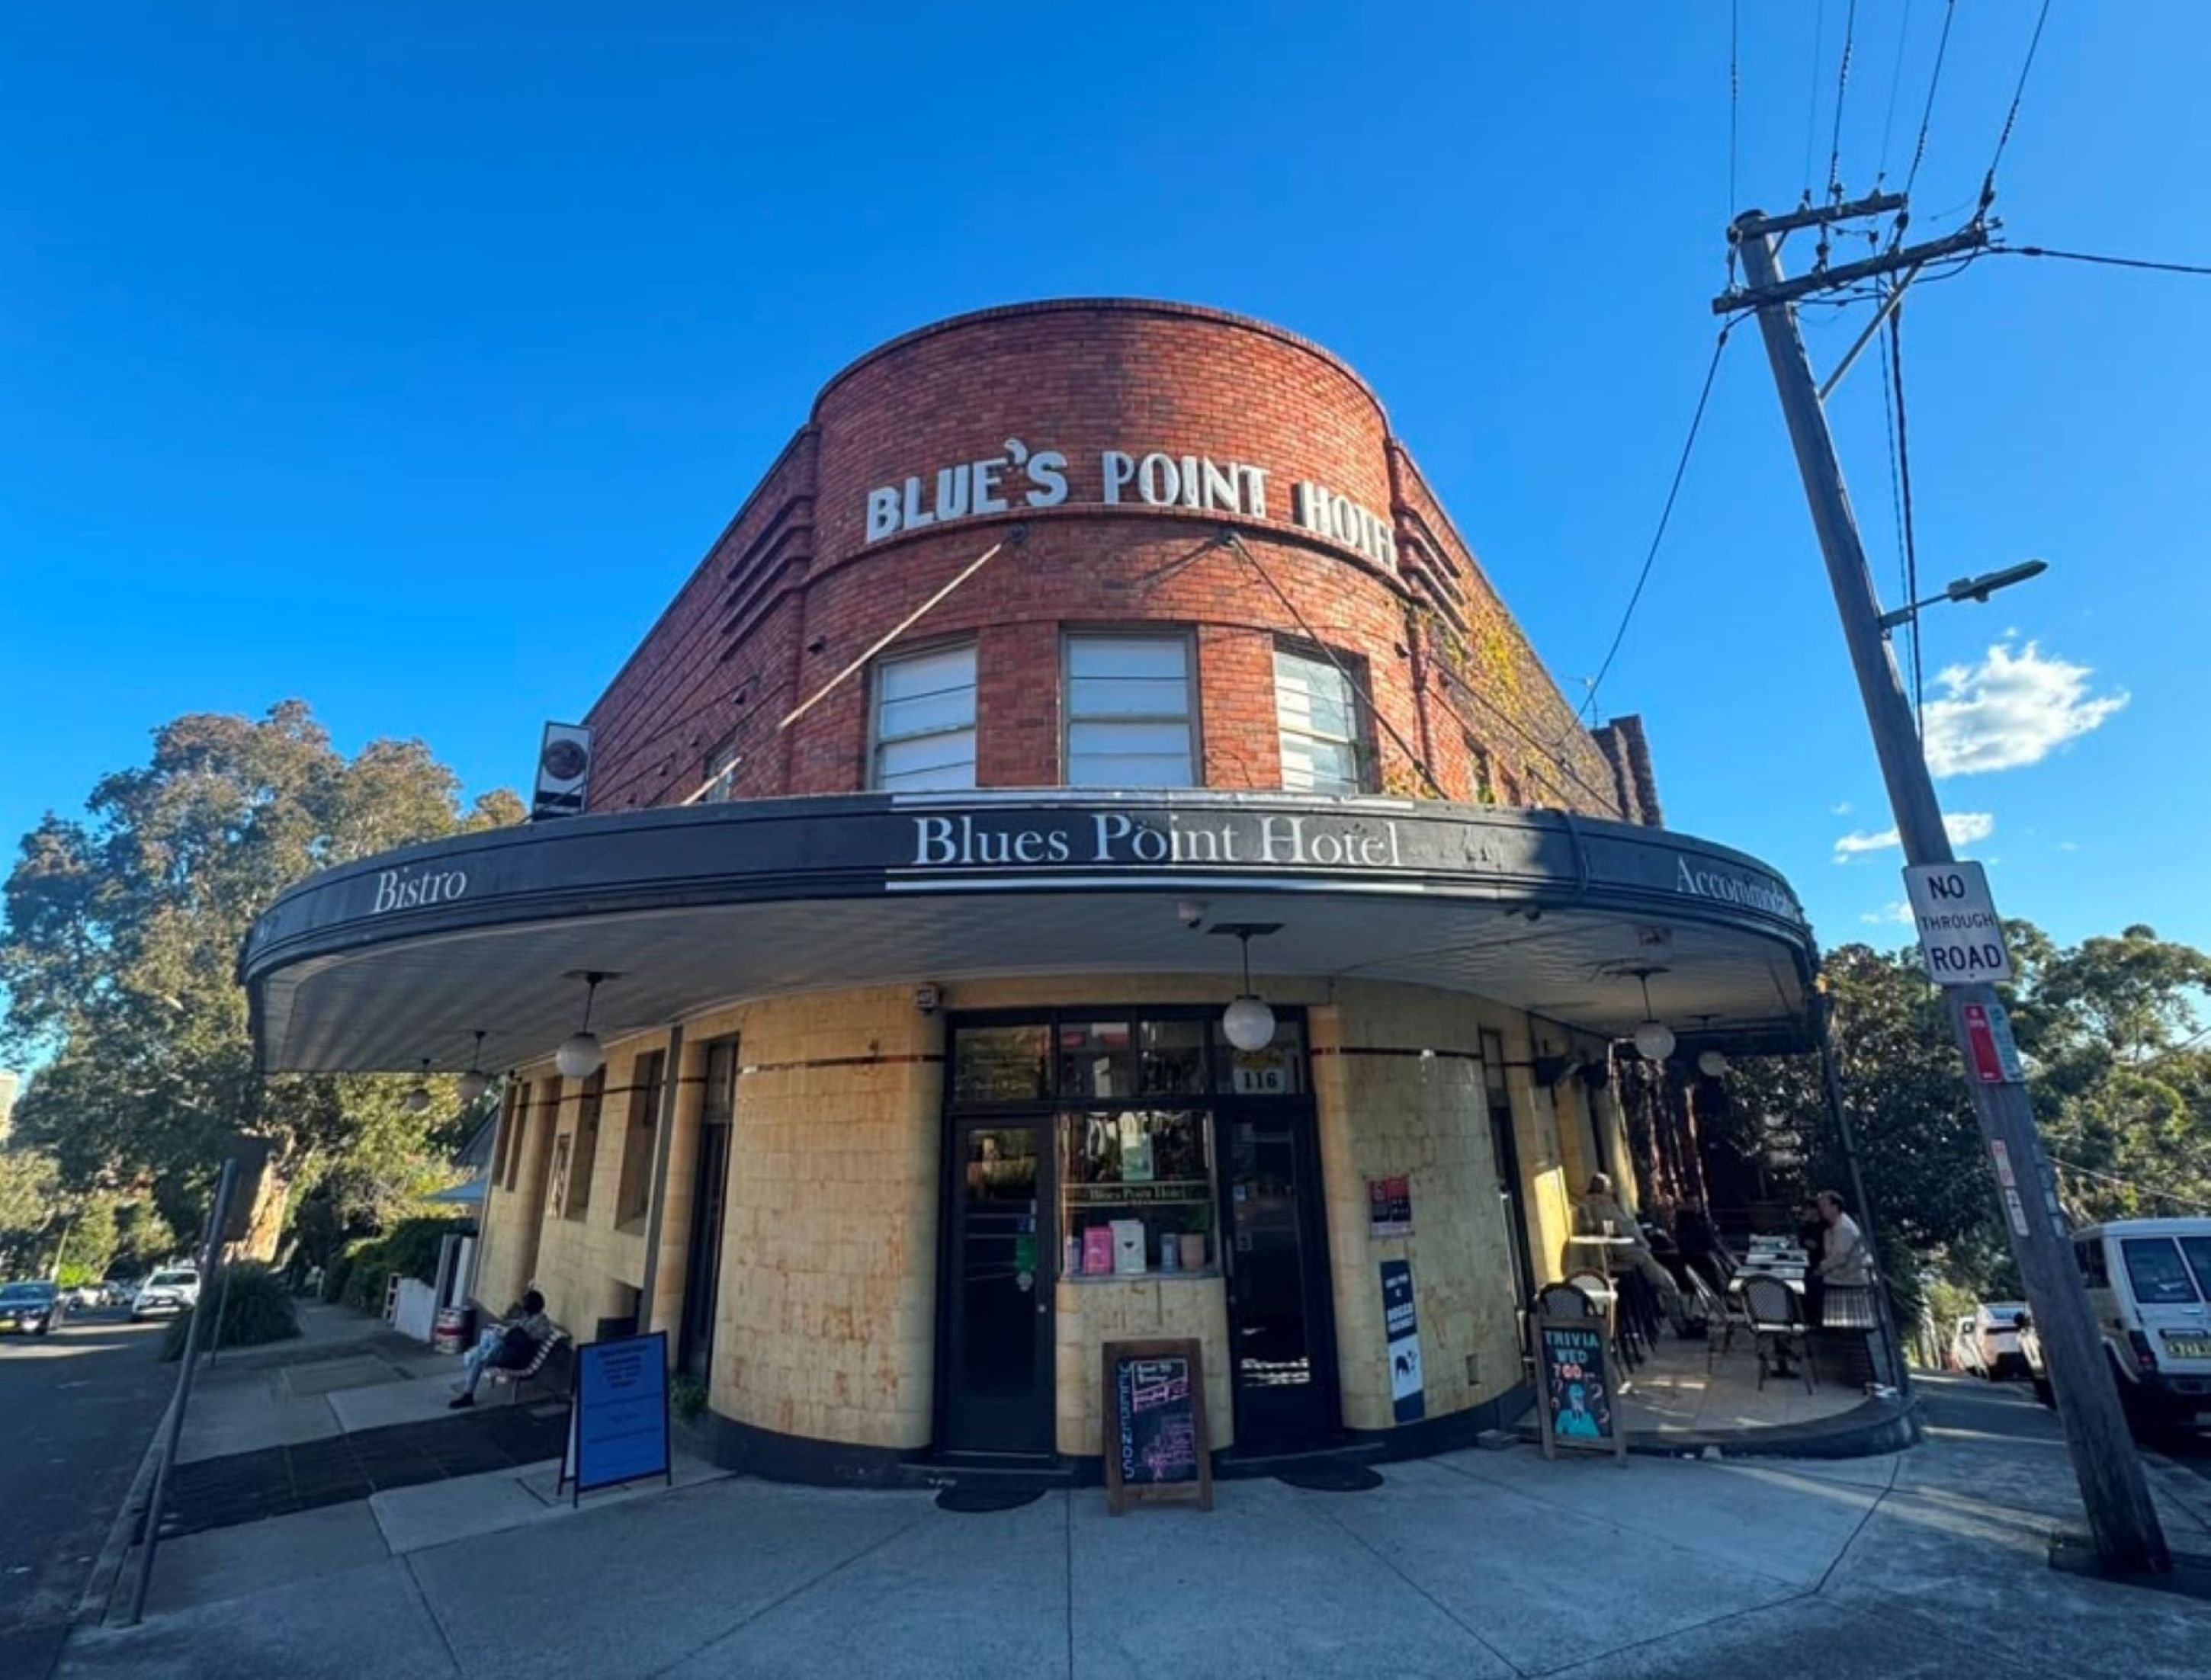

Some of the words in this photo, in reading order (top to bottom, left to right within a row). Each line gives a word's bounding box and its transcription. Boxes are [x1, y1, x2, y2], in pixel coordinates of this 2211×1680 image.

[867, 439, 1068, 543] BLUE'S
[1102, 450, 1267, 519] POINT
[913, 816, 1069, 865] Blues
[1091, 813, 1238, 864] Point
[1258, 816, 1401, 866] Hotel
[371, 866, 467, 912] Bistro
[1927, 874, 1966, 899] NO
[1921, 915, 1994, 932] THROUGH
[1930, 944, 2002, 971] ROAD
[1244, 1072, 1279, 1088] 116
[1545, 1330, 1600, 1348] TRIVIA
